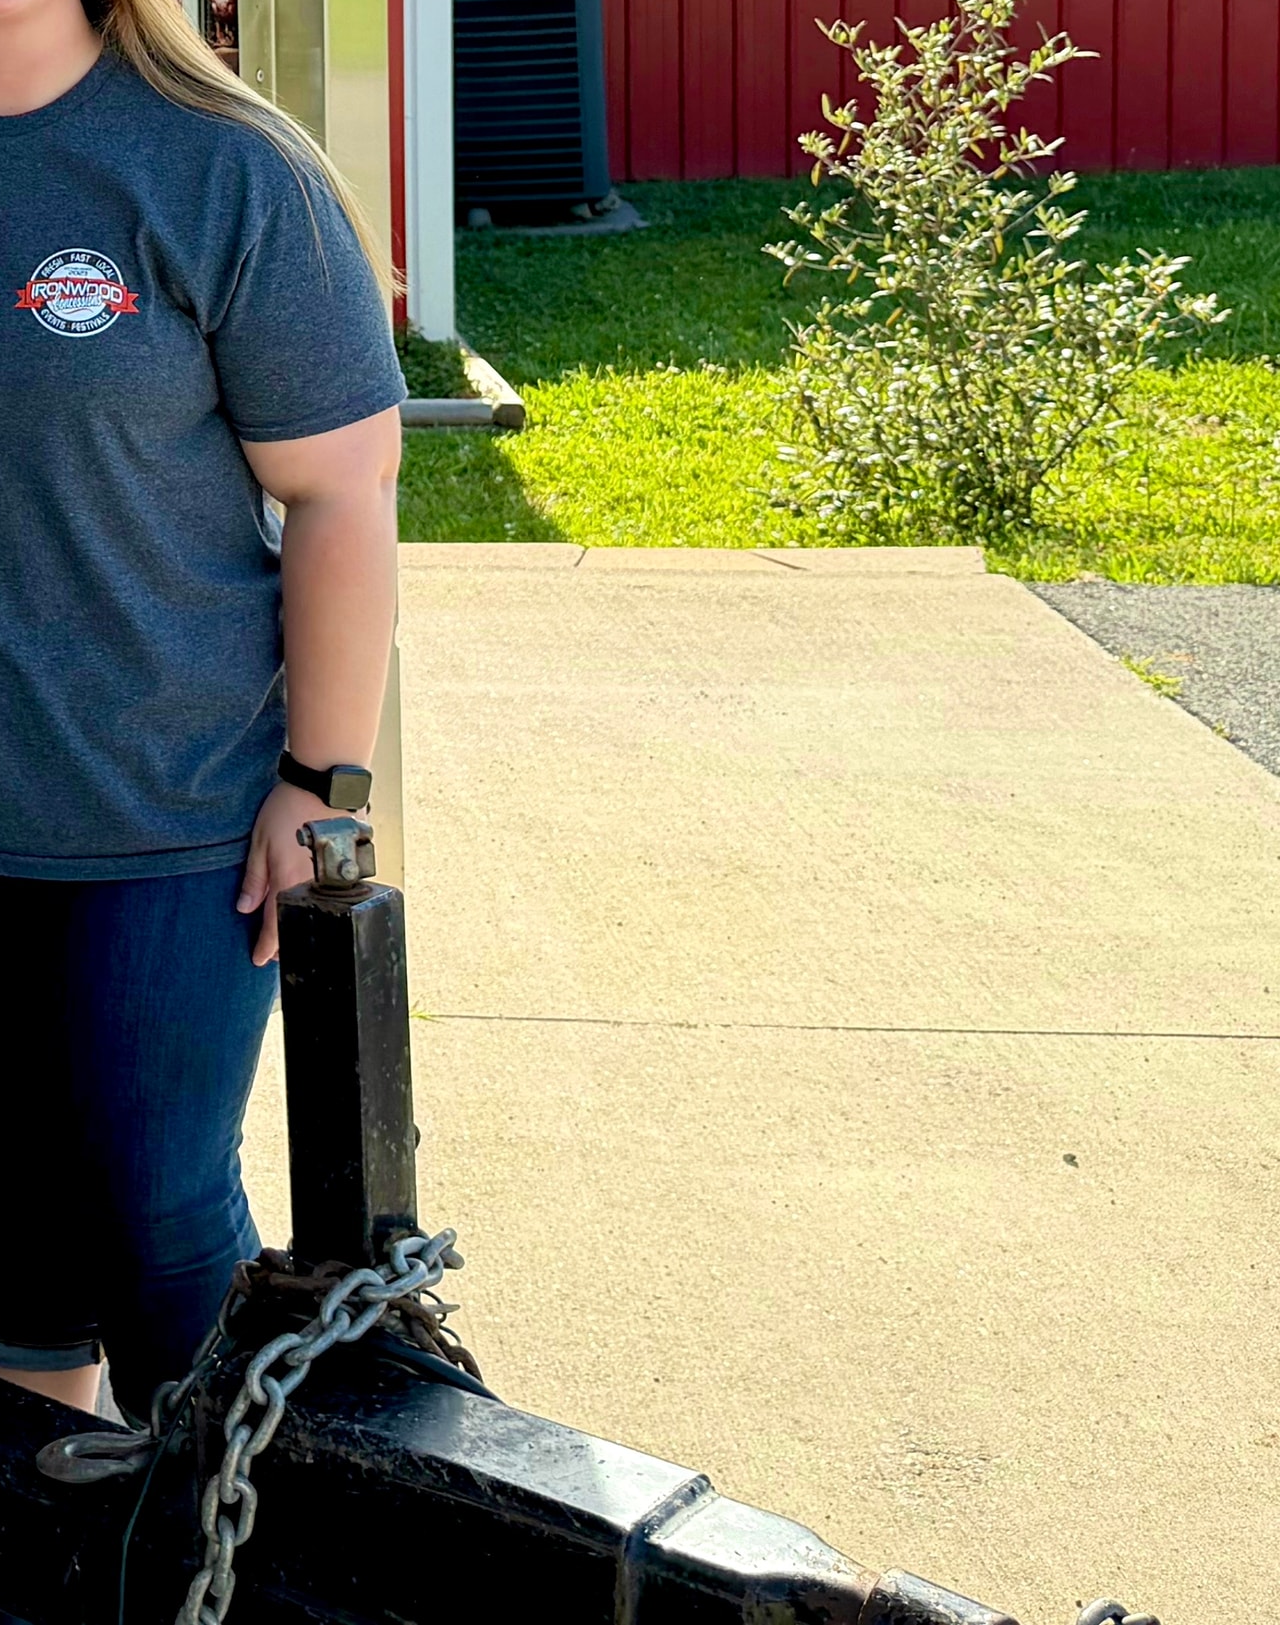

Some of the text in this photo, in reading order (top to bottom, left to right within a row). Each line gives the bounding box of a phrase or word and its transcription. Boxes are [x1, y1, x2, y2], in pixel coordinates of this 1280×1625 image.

[41, 253, 116, 279] FRESH FAST LOCAL
[31, 280, 124, 305] IRONWOOD
[41, 308, 111, 332] EVENTS FESTIVALS
